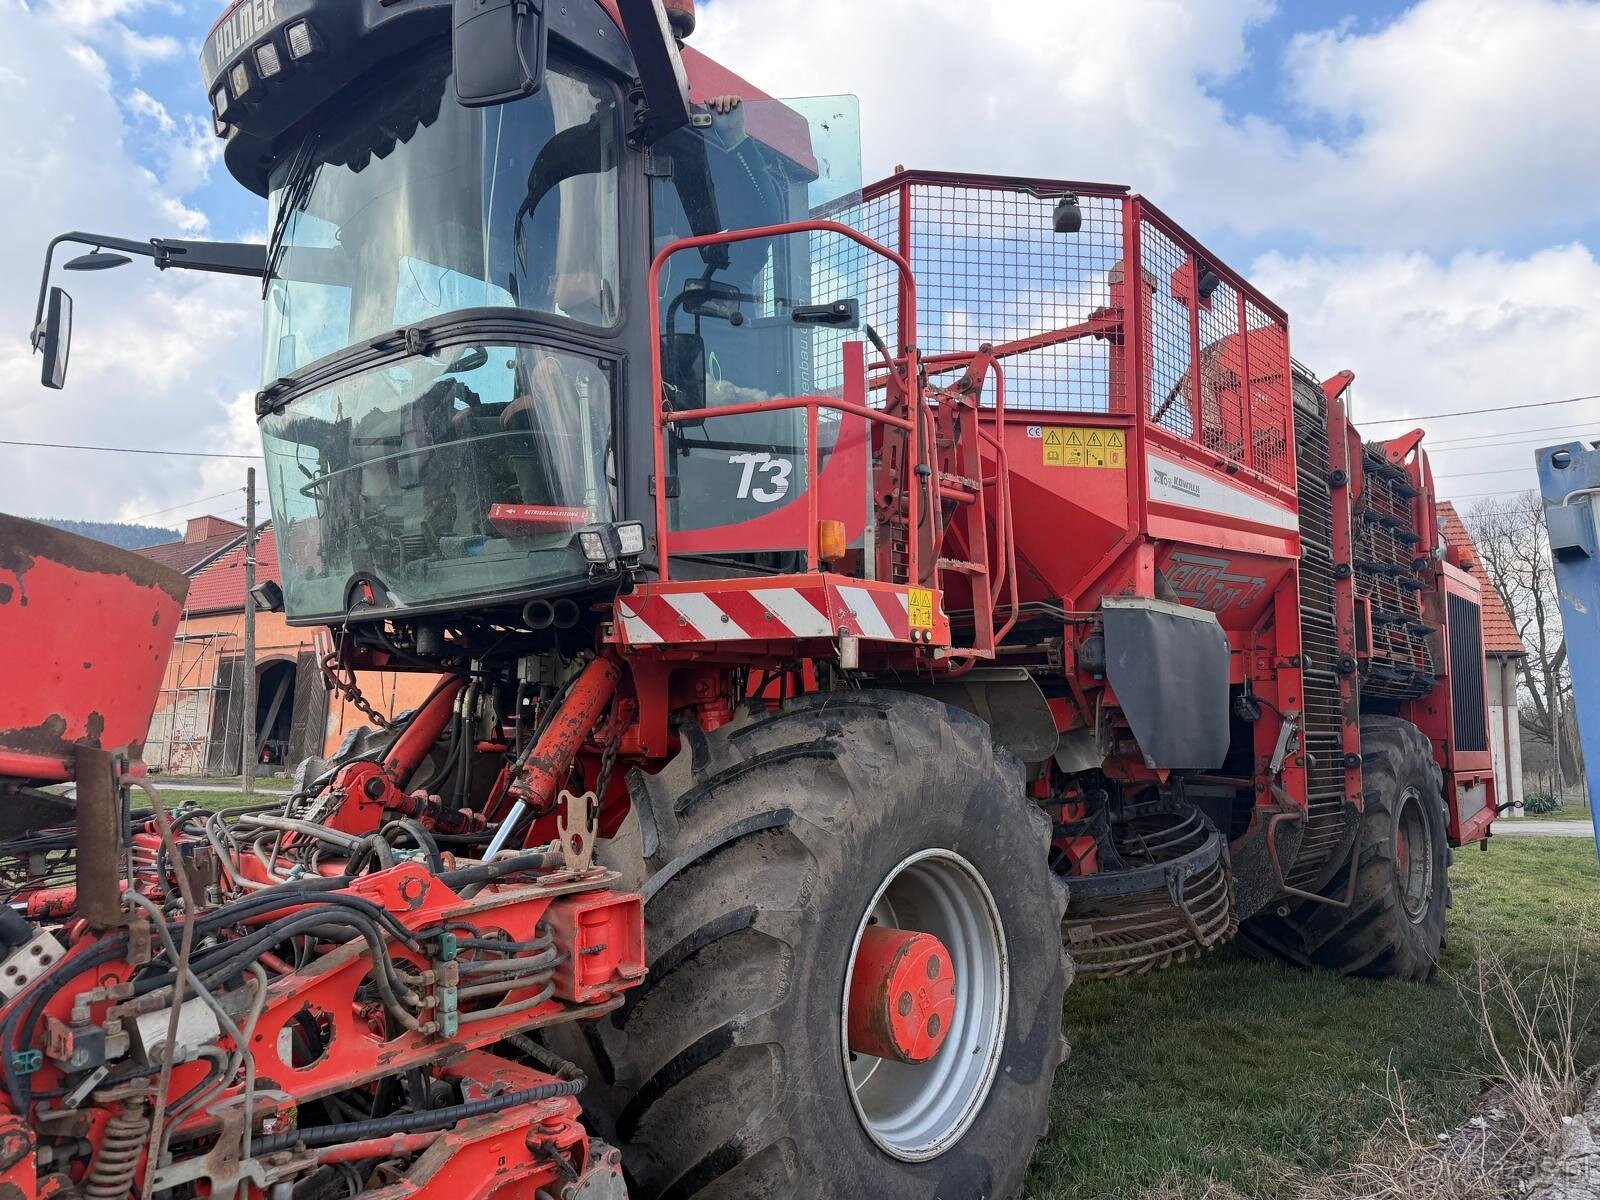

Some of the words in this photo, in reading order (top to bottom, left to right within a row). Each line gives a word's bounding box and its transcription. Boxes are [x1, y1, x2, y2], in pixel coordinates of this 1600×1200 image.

[215, 0, 276, 67] HOLMER
[728, 452, 793, 503] T3
[524, 509, 579, 518] BETRIEBSANLEITUNG
